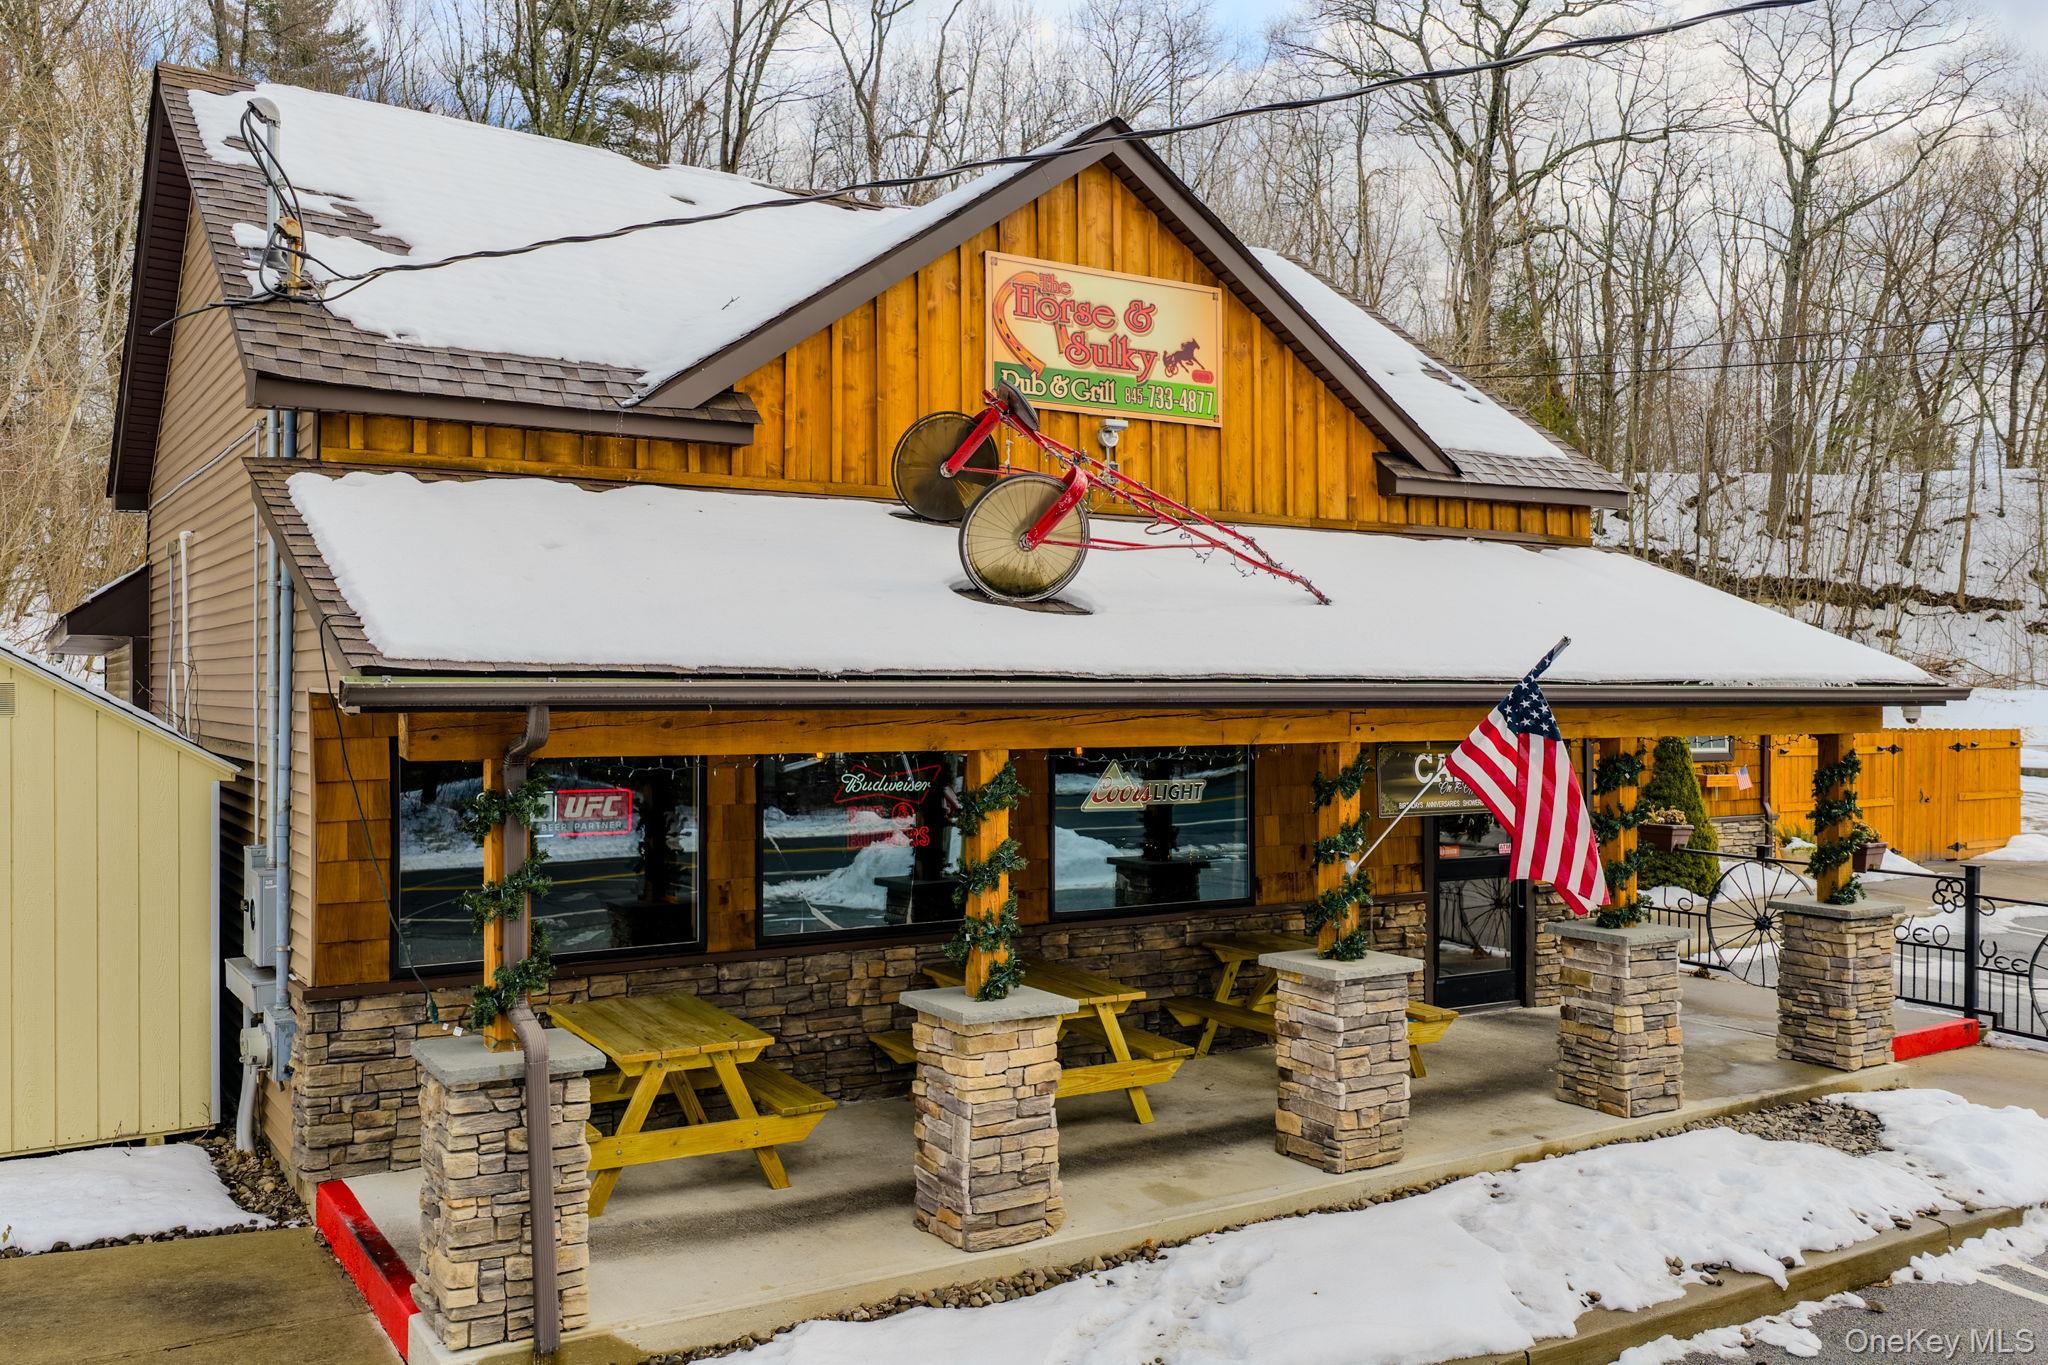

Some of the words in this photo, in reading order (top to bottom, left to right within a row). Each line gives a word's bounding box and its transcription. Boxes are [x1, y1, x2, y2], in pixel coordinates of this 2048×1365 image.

[1038, 272, 1072, 296] The
[1012, 282, 1117, 330] Horse
[1123, 299, 1158, 334] &
[1063, 330, 1158, 384] Sulky
[1001, 368, 1047, 397] Pub
[1049, 373, 1069, 399] &
[1071, 377, 1117, 404] Grill
[1125, 384, 1215, 415] 845-733-4877
[841, 773, 931, 793] Budweiser
[1091, 776, 1152, 804] Coors
[1153, 782, 1205, 801] LIGHT
[564, 796, 623, 818] UFC
[1425, 800, 1459, 808] ANNIVERSARIES
[541, 823, 567, 832] BEER
[574, 821, 622, 831] PARTNER
